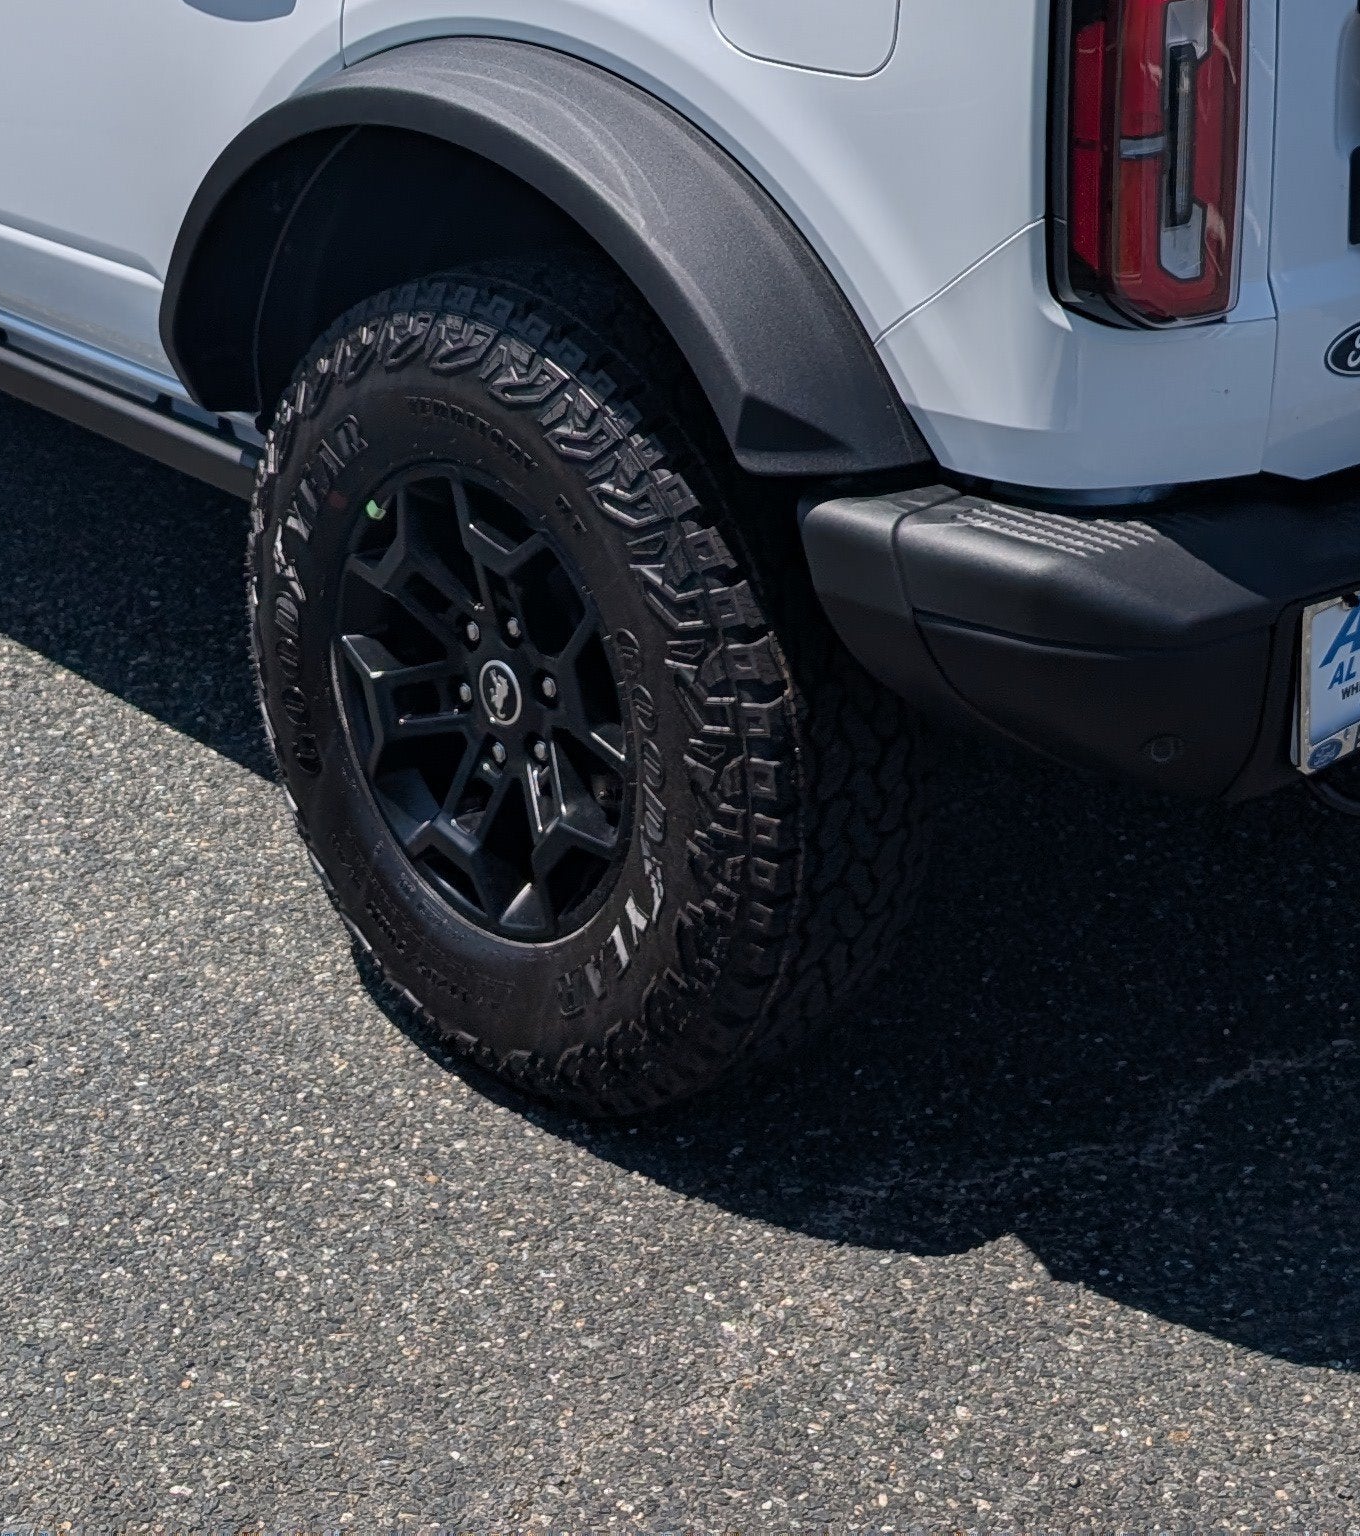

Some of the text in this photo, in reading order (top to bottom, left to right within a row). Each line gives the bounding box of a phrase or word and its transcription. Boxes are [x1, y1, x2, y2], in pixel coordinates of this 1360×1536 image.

[272, 410, 372, 775] GOODYEAR
[1328, 656, 1357, 690] AL
[558, 626, 668, 1019] GOODYEAR
